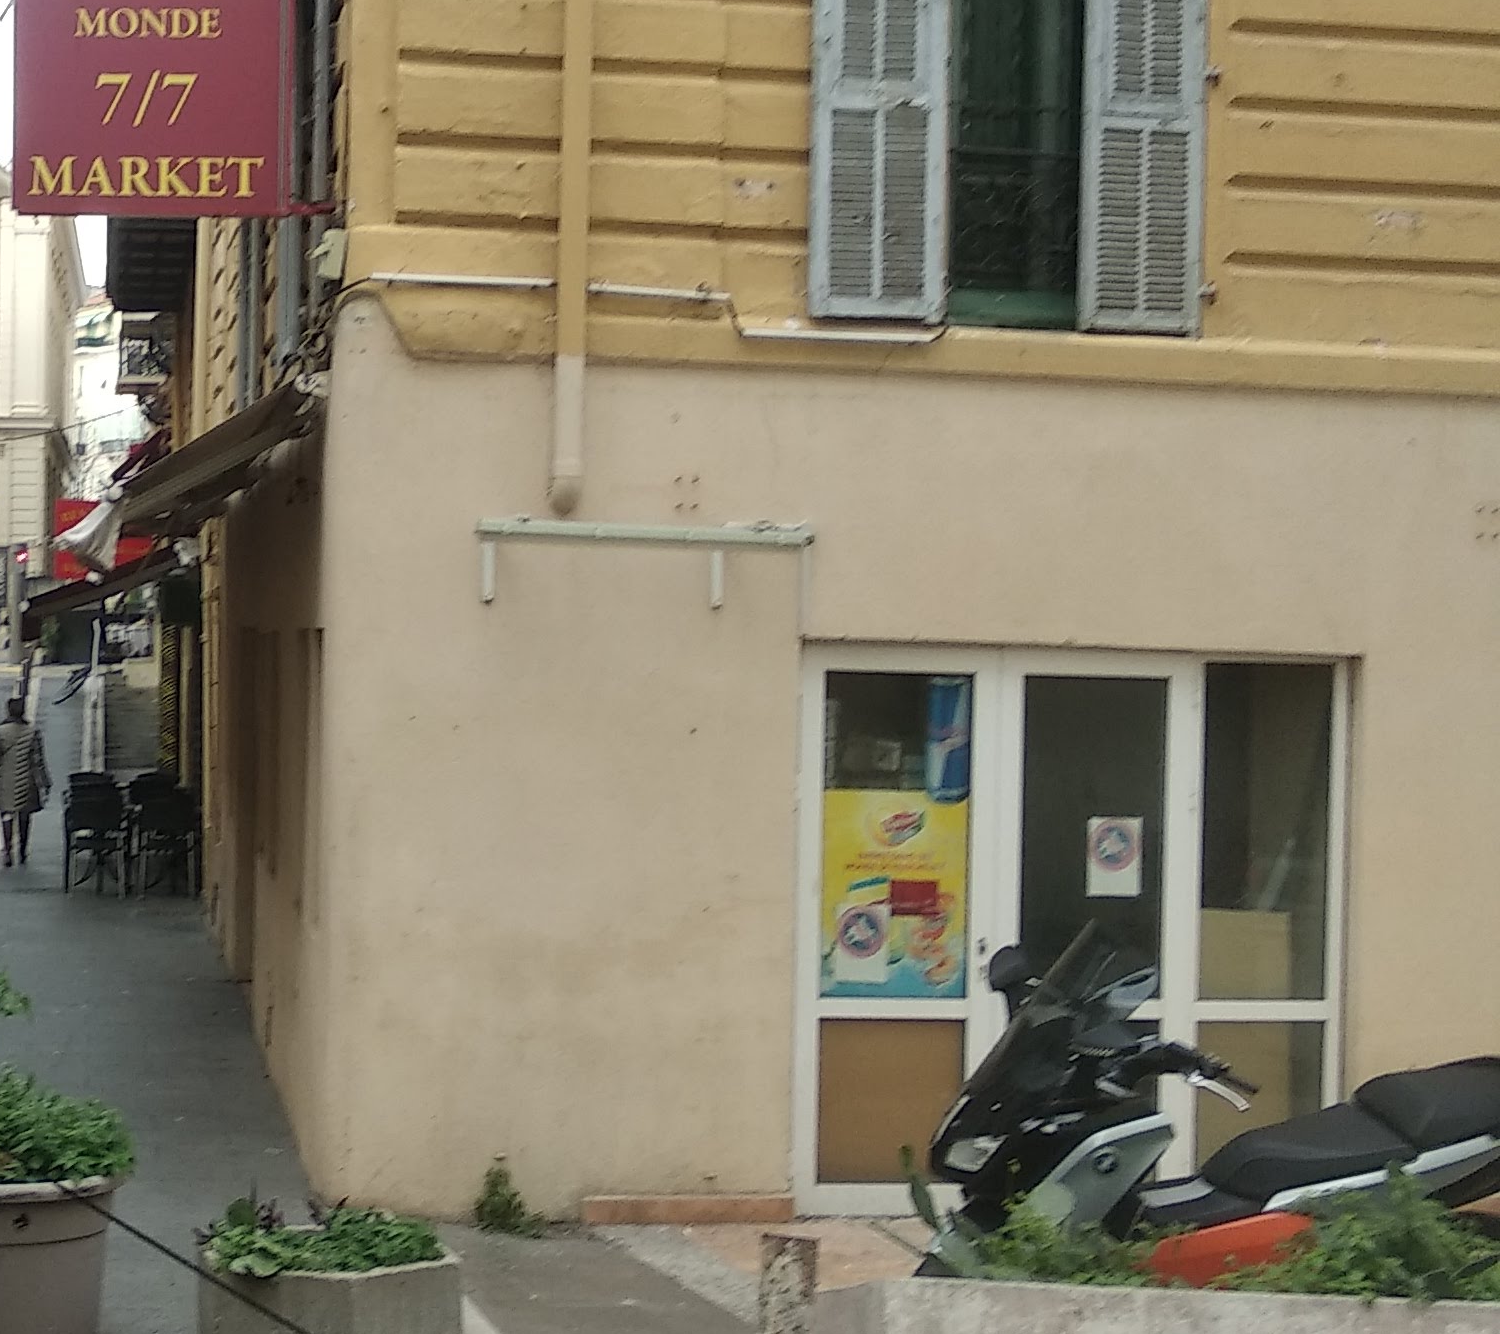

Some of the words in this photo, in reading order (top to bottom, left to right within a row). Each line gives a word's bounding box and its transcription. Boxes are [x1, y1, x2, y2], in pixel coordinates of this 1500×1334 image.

[73, 7, 223, 40] MONDE
[94, 69, 199, 128] 7/7
[26, 154, 266, 198] MARKET
